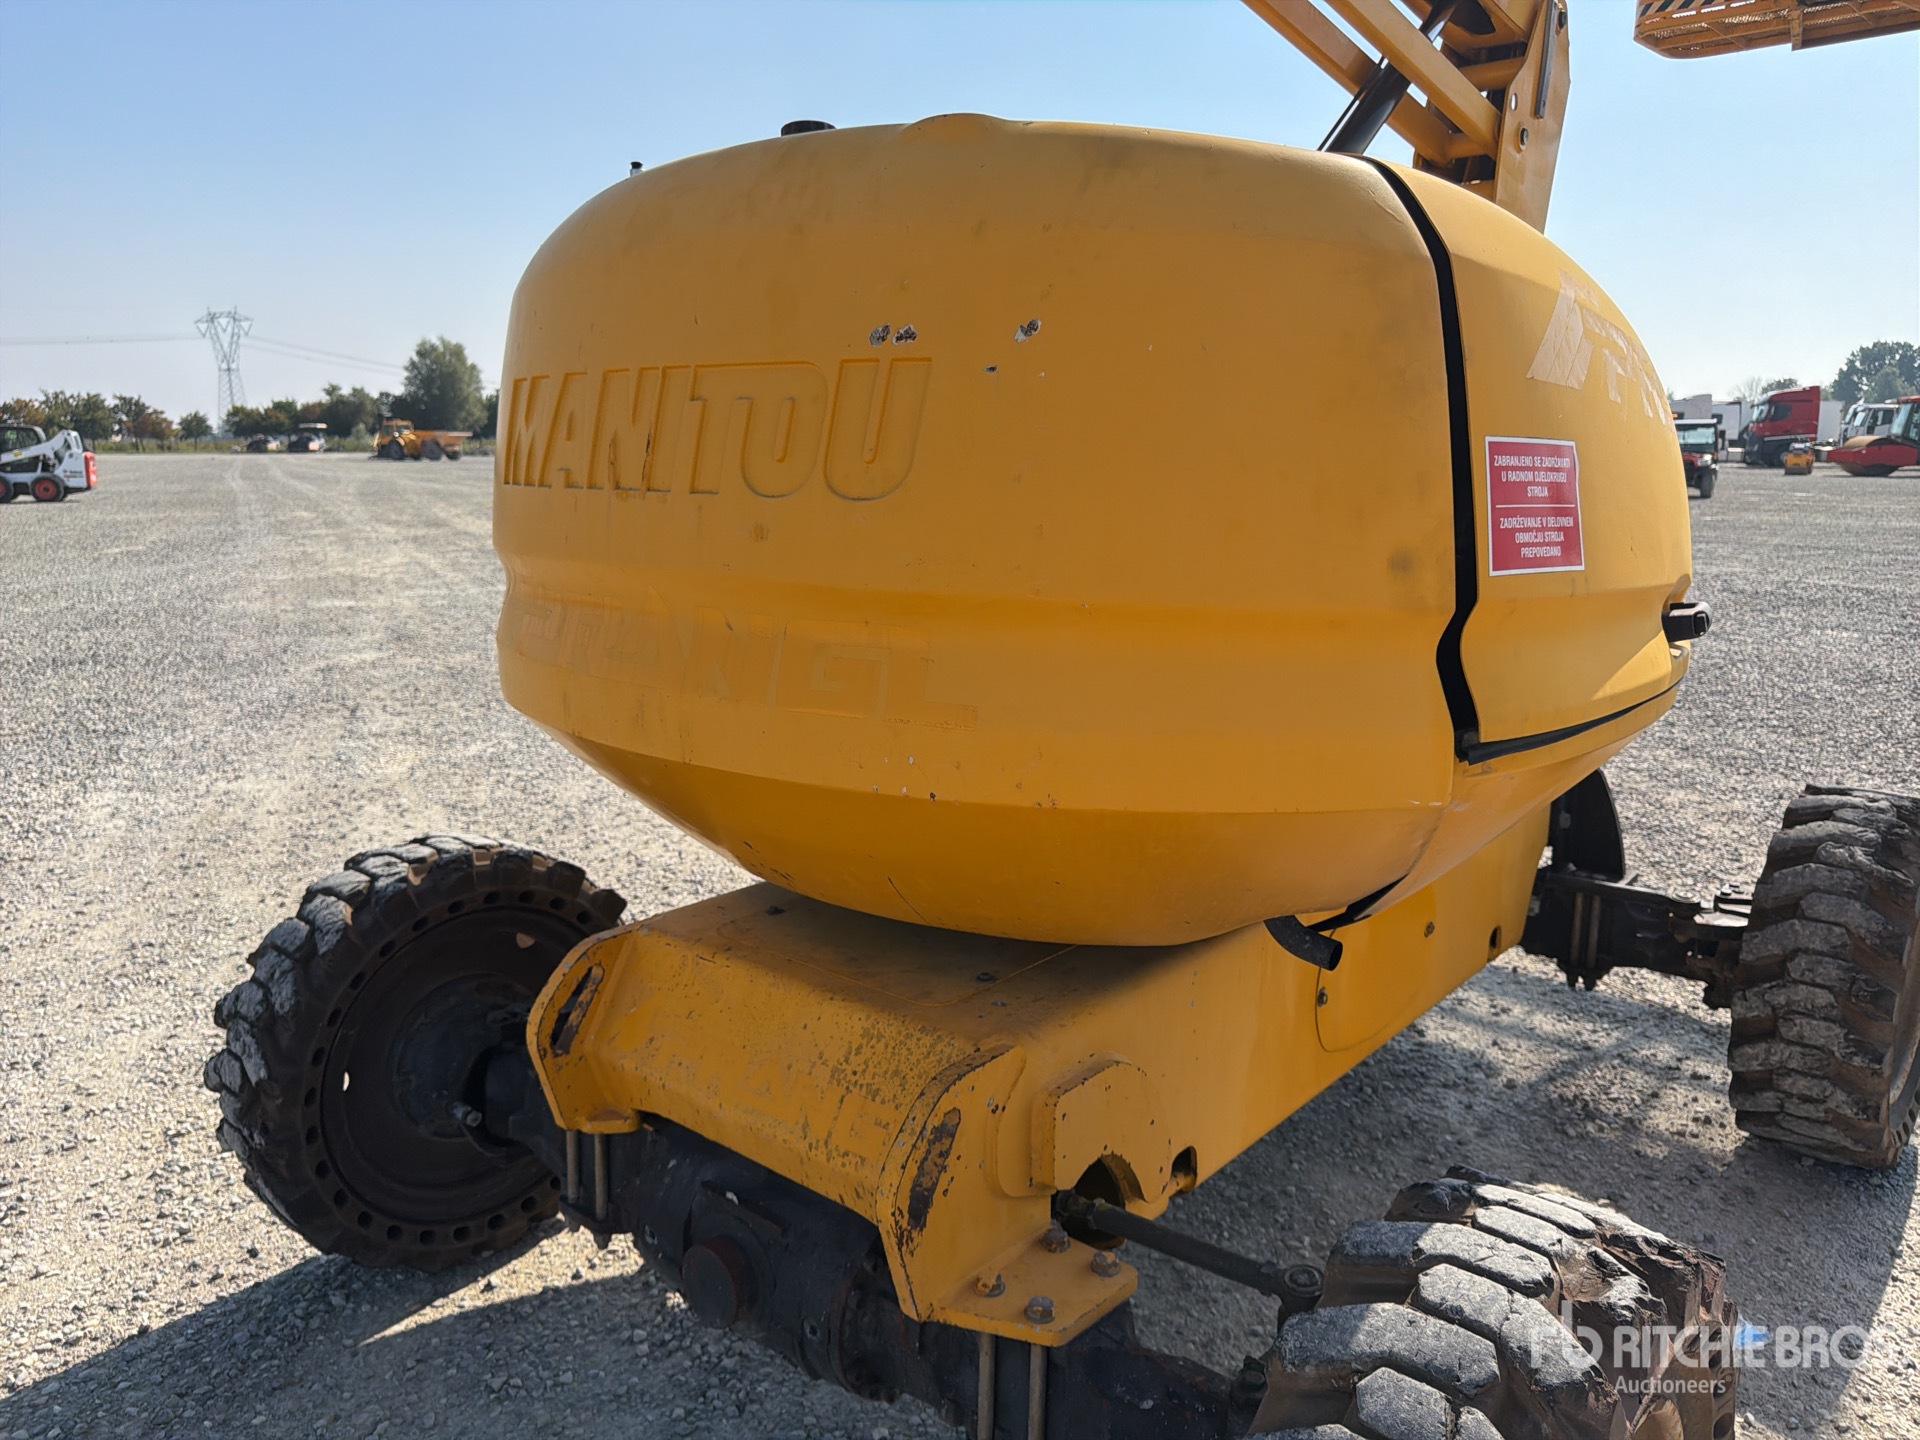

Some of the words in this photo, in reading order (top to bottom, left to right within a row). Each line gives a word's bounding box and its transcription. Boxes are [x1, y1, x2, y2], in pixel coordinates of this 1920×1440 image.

[503, 356, 933, 501] MANITOU
[1494, 455, 1533, 467] ZABRANJENO
[1534, 456, 1541, 467] SE
[1501, 471, 1507, 482] U
[1508, 471, 1534, 482] RADNOM
[1534, 472, 1567, 483] DJELOKRUGU
[1527, 486, 1549, 497] STROJA
[1500, 515, 1541, 528] ZADRŽEVANJE
[1542, 517, 1547, 527] V
[1547, 516, 1574, 527] DELOVNEM
[1515, 529, 1543, 543] OBMOČJU
[1544, 531, 1565, 542] STROJA
[1521, 546, 1561, 558] PREPOVEDANO
